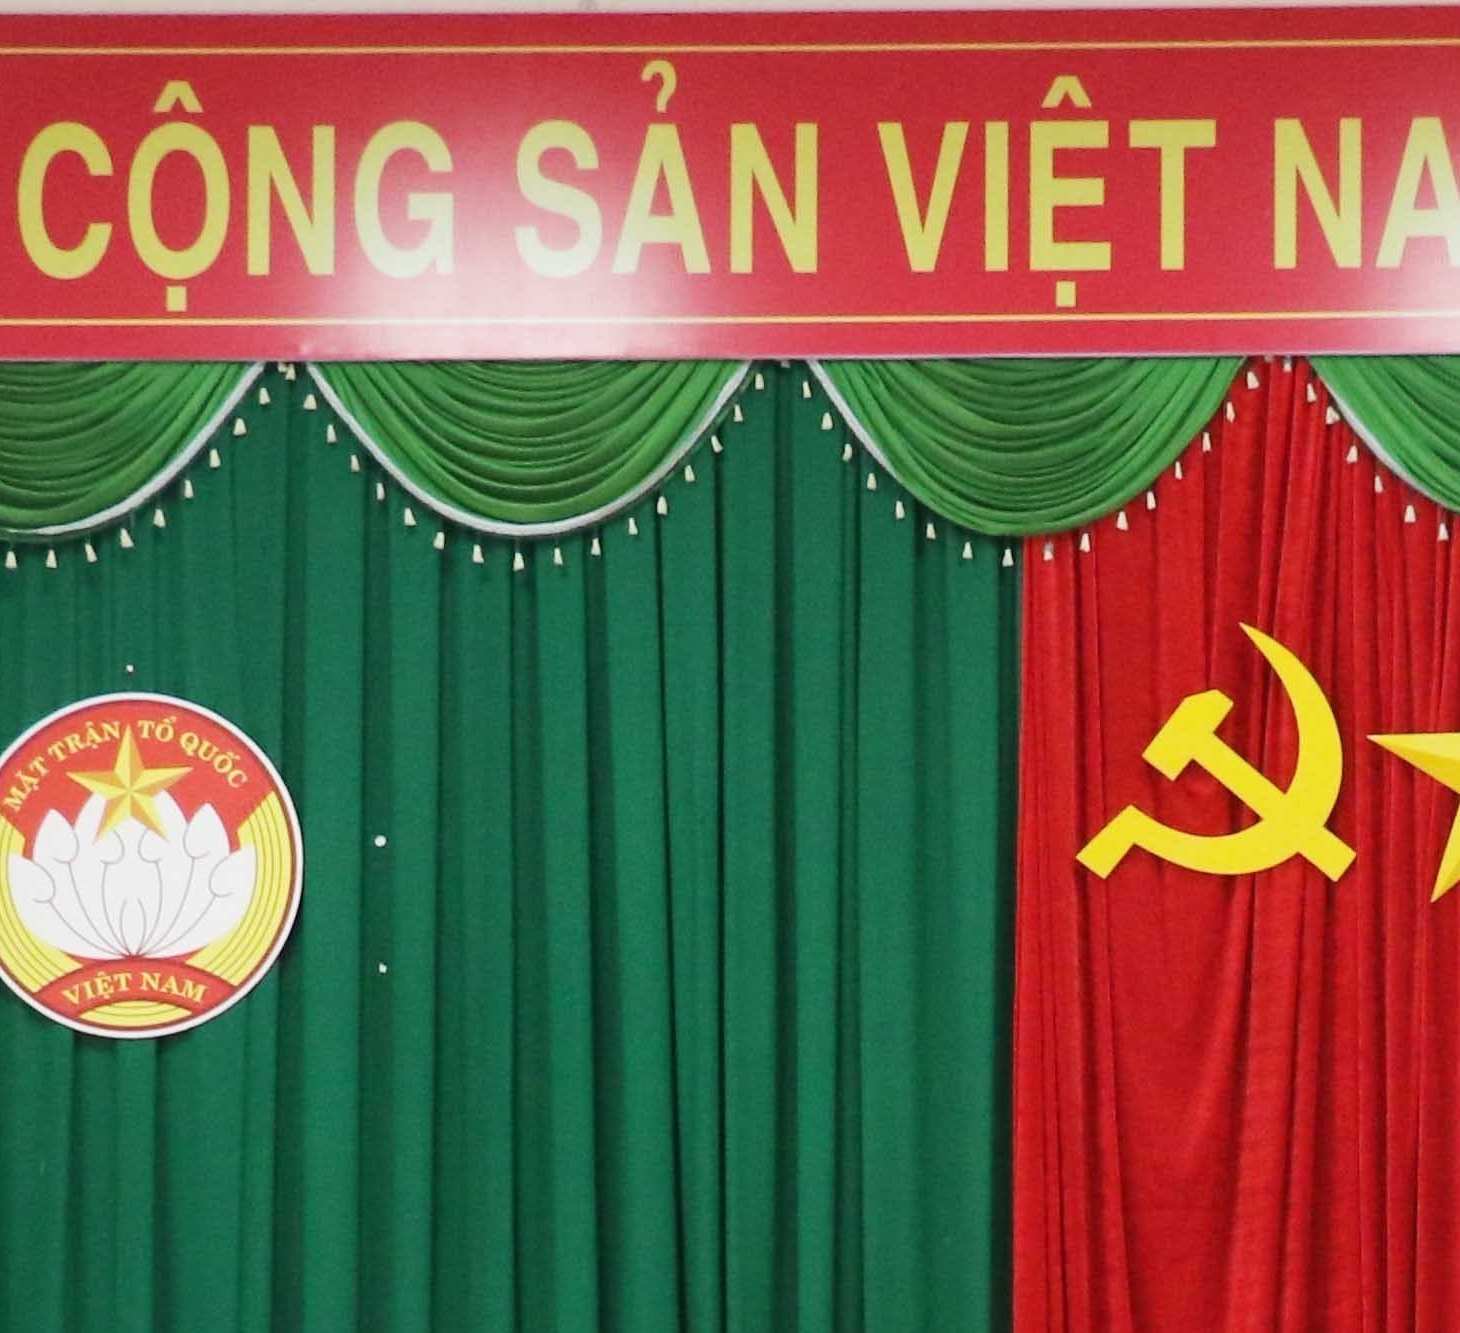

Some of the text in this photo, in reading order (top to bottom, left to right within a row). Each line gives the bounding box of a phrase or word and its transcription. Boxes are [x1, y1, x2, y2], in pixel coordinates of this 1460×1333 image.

[17, 80, 454, 312] CỘNG
[514, 60, 819, 279] SẢN
[879, 75, 1217, 308] VIỆT
[3, 715, 249, 812] MẶT TRẬN TỔ QUỐC
[61, 971, 208, 1005] VIỆT NAM
